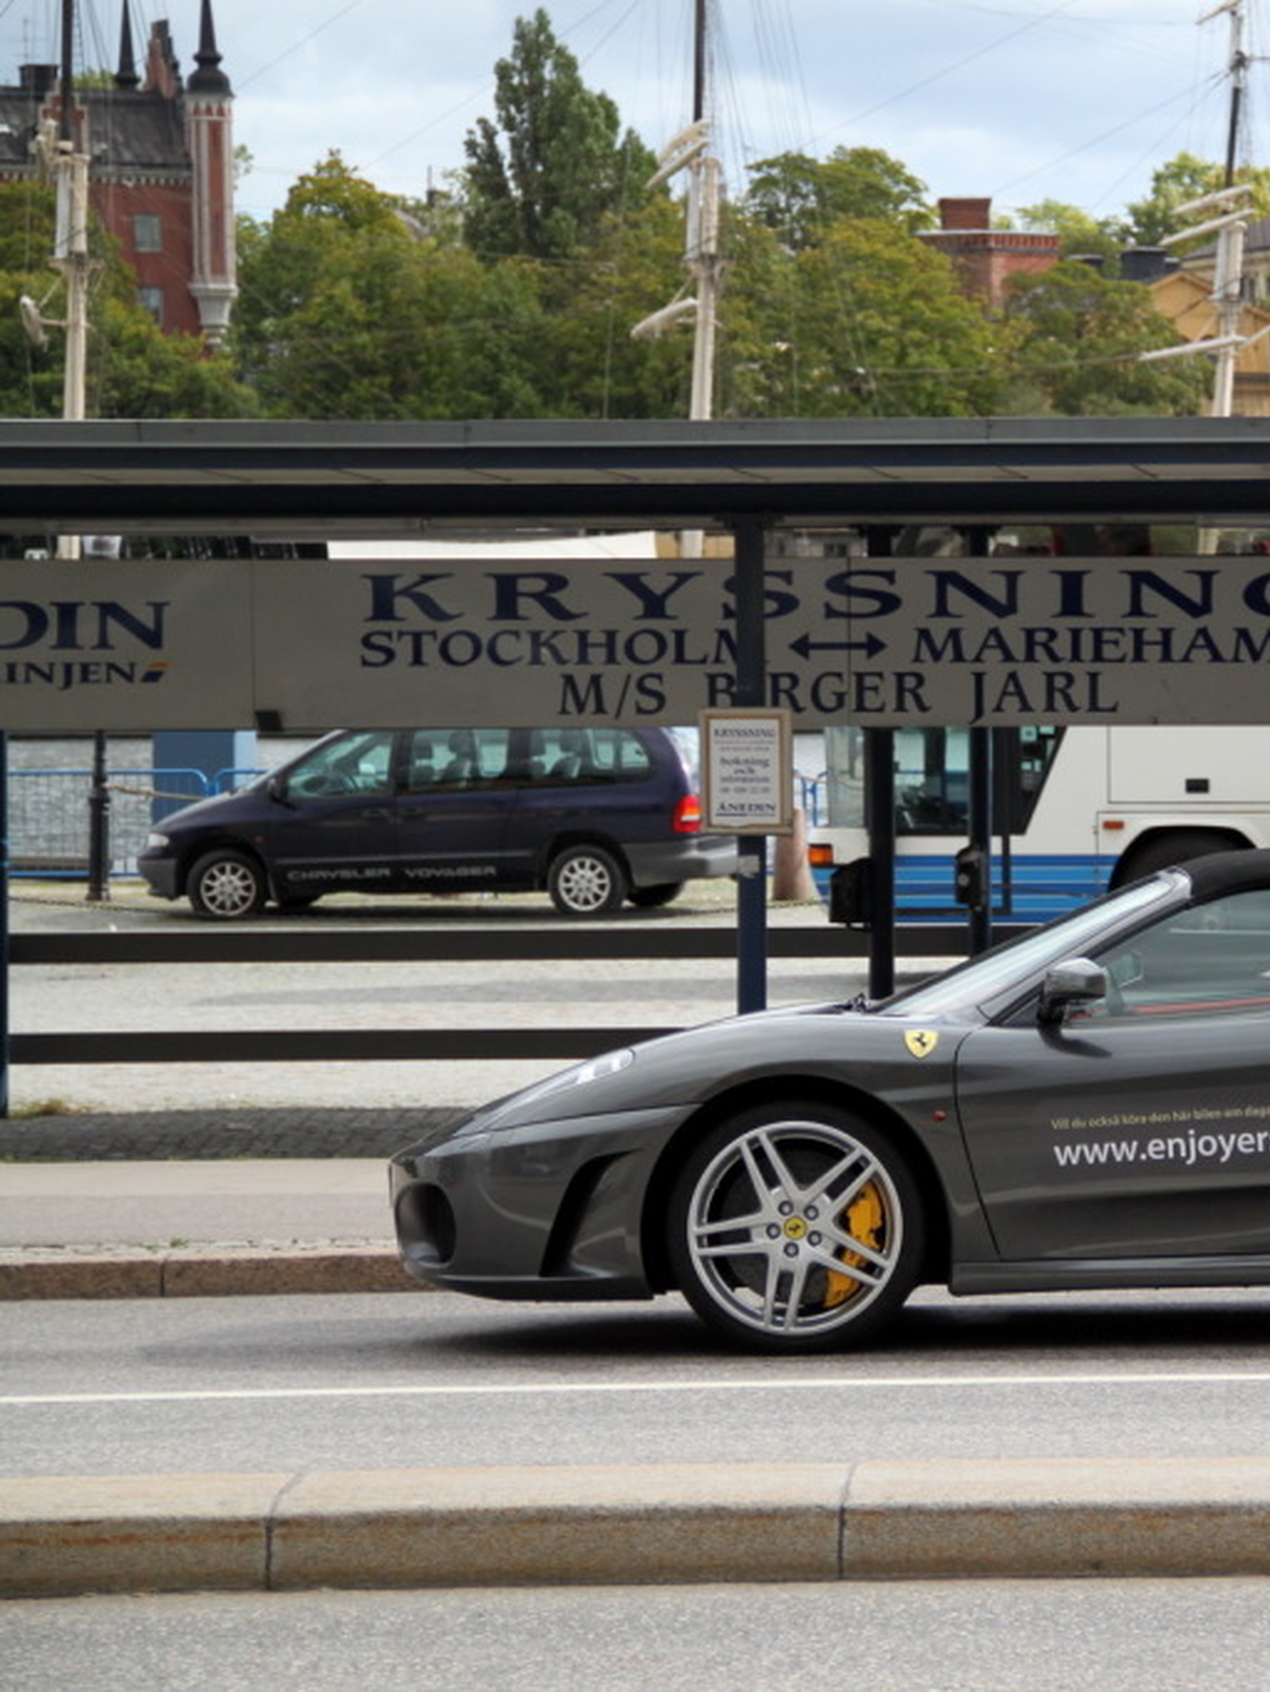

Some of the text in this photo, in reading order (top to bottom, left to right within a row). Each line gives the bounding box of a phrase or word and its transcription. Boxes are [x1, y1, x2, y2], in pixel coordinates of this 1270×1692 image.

[557, 670, 1119, 725] M/S BRGER JARL
[287, 865, 497, 881] CHRYSLER VOYAGER
[1051, 1117, 1070, 1129] Vill
[1071, 1117, 1087, 1129] du
[1089, 1115, 1119, 1128] också
[1149, 1111, 1171, 1123] den
